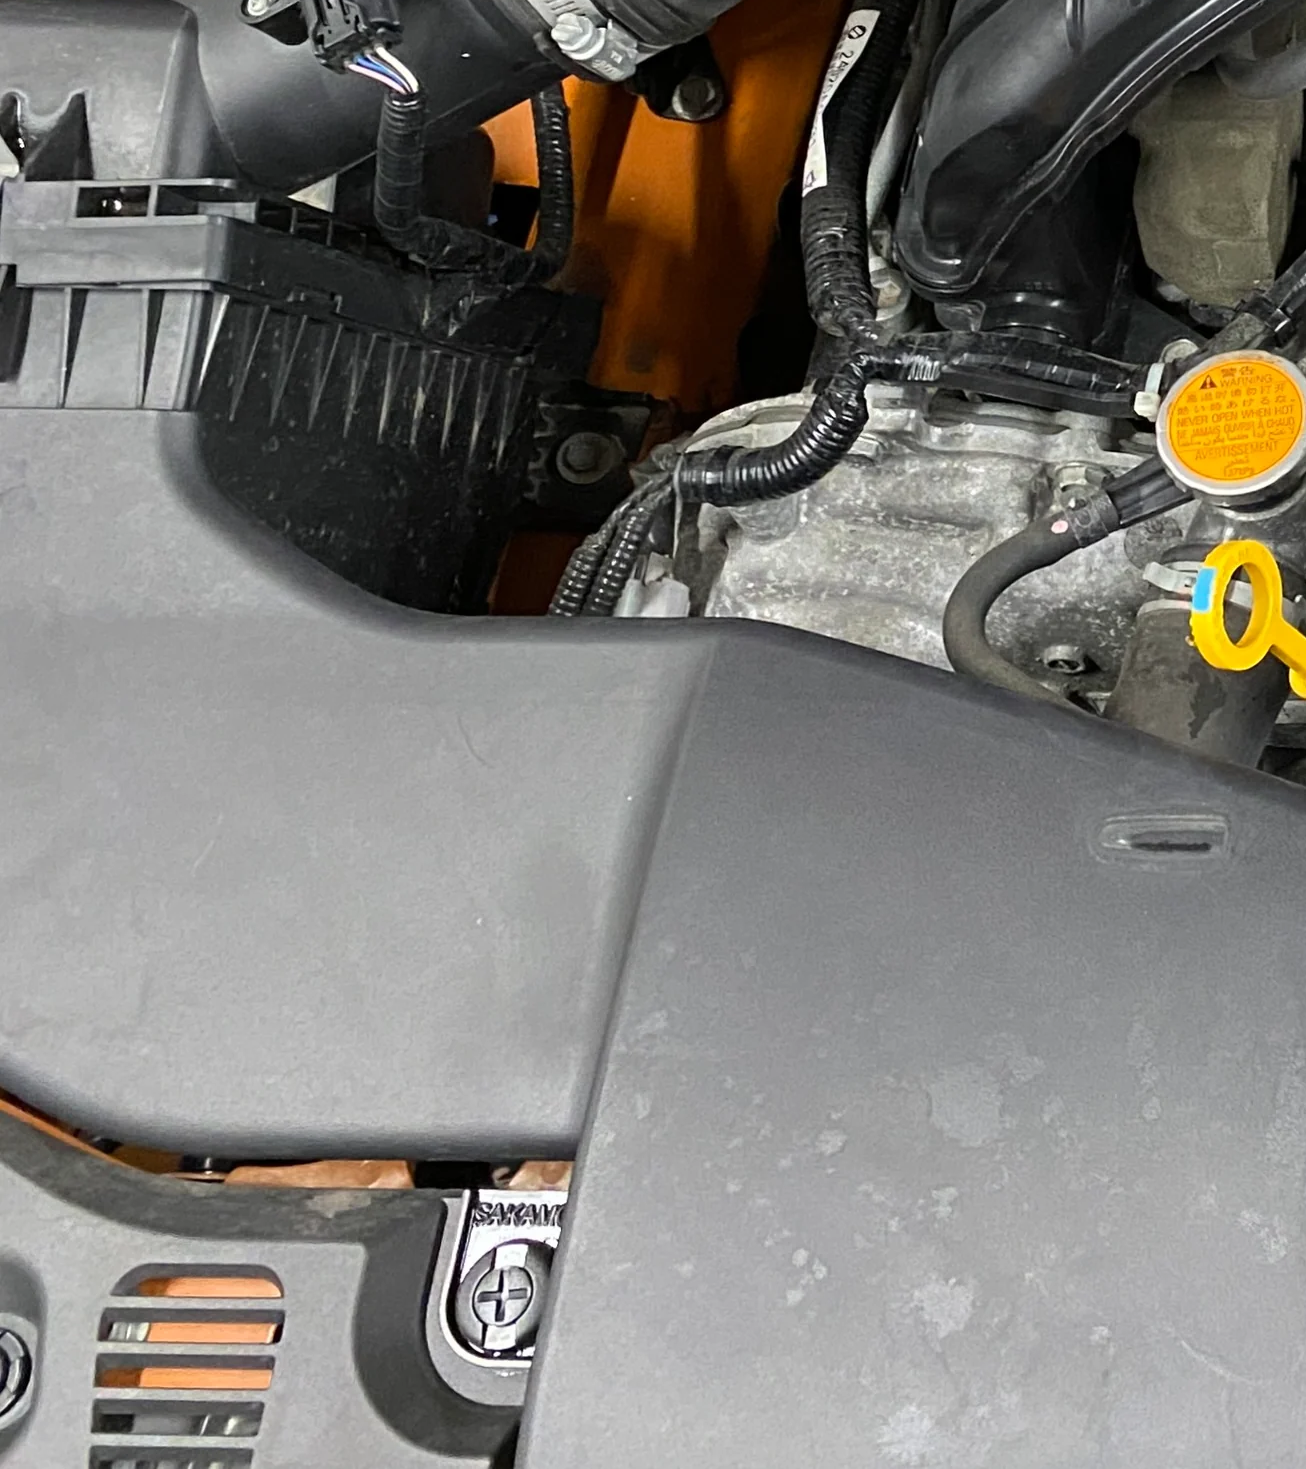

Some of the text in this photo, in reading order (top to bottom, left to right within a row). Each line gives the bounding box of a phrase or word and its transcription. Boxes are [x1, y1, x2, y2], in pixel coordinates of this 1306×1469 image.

[1219, 374, 1273, 388] WARNING
[1176, 404, 1295, 428] NEVER OPEN WHEN HOT
[1192, 425, 1221, 437] JAMAIS
[1266, 416, 1295, 429] CHAUD
[1195, 441, 1279, 460] AVERTISSEMENT
[473, 1202, 563, 1227] SAKAM
